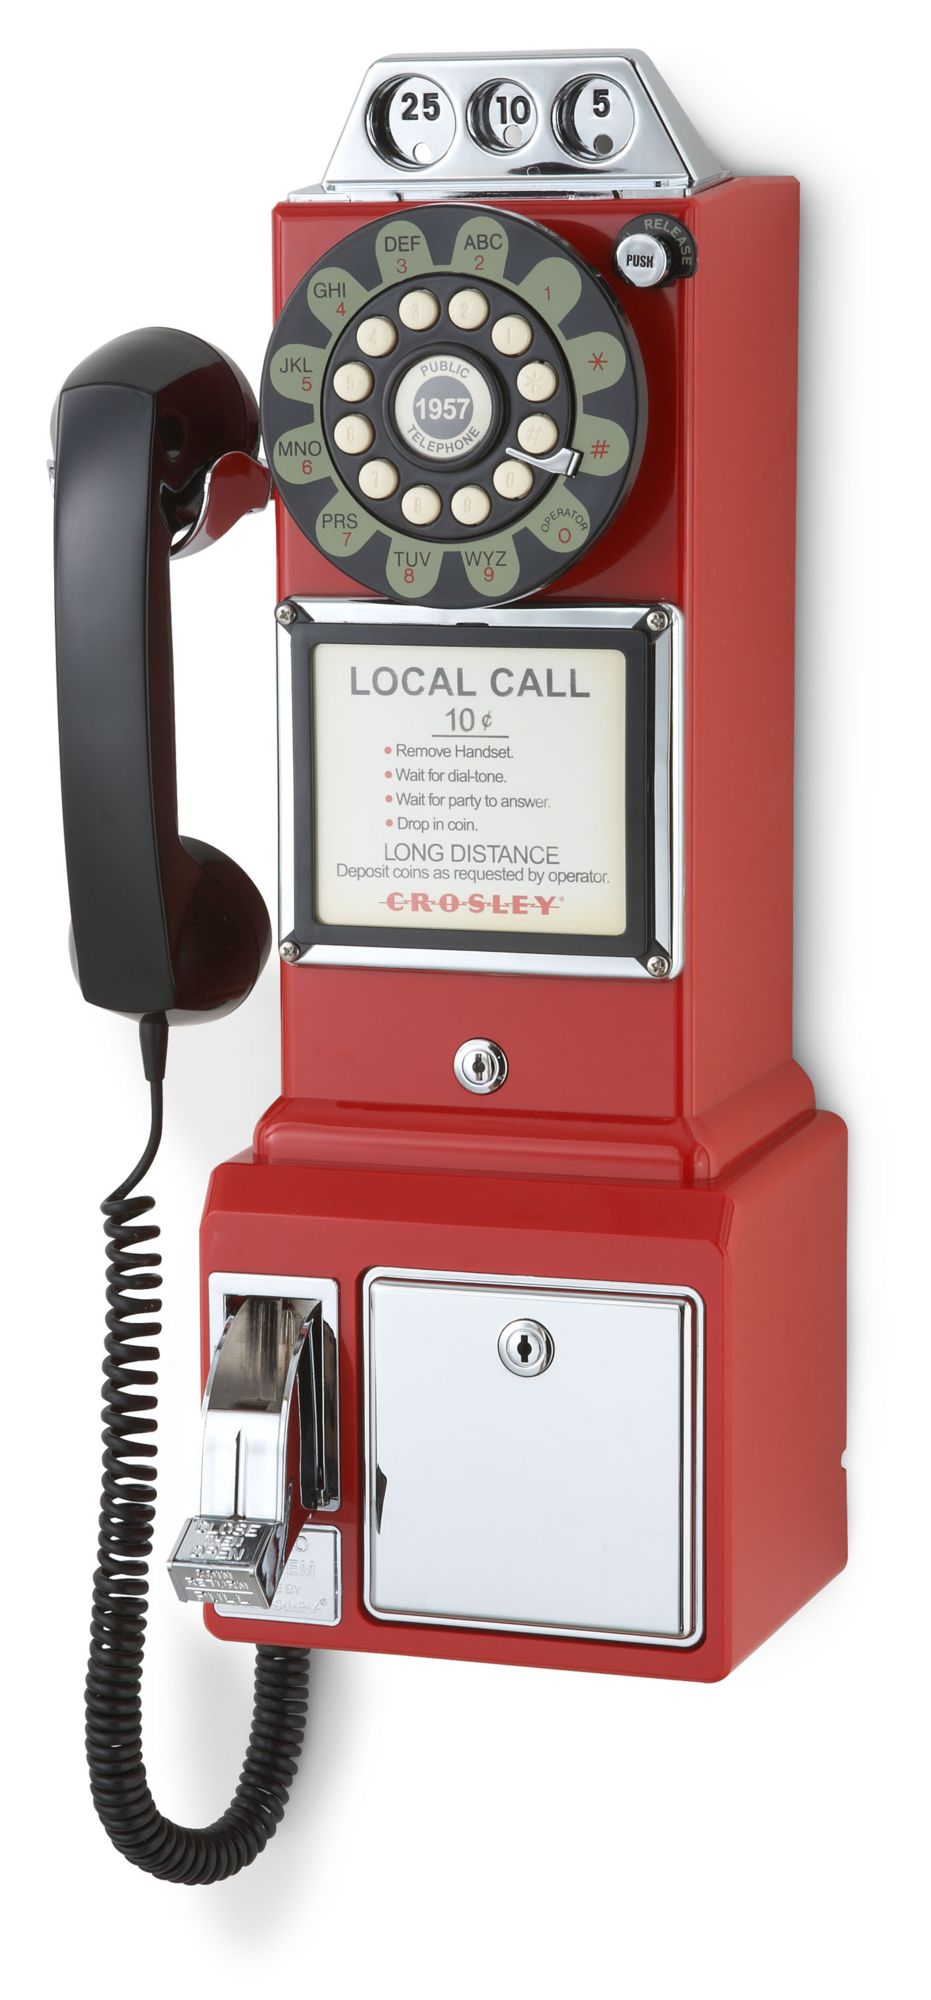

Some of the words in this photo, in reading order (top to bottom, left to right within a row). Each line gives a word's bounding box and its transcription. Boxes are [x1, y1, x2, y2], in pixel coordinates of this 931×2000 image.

[401, 92, 441, 121] 25
[495, 96, 531, 125] 10
[592, 88, 611, 118] 5
[384, 235, 421, 252] DEF
[464, 233, 503, 251] ABC
[644, 218, 692, 266] RELEASE
[396, 258, 407, 274] 3
[473, 255, 485, 271] 2
[626, 254, 654, 268] PUSH
[313, 282, 346, 299] GHI
[544, 285, 551, 301] 1
[335, 302, 347, 317] 4
[279, 357, 313, 374] JKL
[420, 360, 470, 379] PUBLIC
[301, 376, 313, 392] 5
[415, 397, 471, 421] 1957
[407, 423, 480, 454] TELEPHONE
[278, 440, 322, 457] MNO
[302, 459, 313, 475] 6
[322, 513, 358, 530] PRS
[540, 507, 589, 533] OPERATOR
[342, 532, 353, 547] 7
[393, 551, 432, 567] TUV
[464, 550, 507, 567] WYZ
[403, 568, 415, 584] 8
[483, 566, 495, 583] 9
[350, 665, 477, 697] LOCAL
[489, 667, 591, 698] CALL
[445, 707, 476, 733] 10
[481, 710, 493, 731] ¢
[395, 743, 452, 758] Remove
[455, 744, 514, 760] Handset.
[395, 768, 425, 783] Wait
[428, 768, 445, 783] for
[448, 768, 507, 784] dial-tone.
[396, 792, 426, 807] Wait
[428, 792, 445, 807] for
[448, 794, 482, 811] party
[484, 794, 498, 808] to
[500, 796, 552, 809] answer.
[397, 816, 430, 834] Drop
[432, 817, 444, 831] in
[447, 817, 479, 832] coin.
[384, 842, 445, 863] LONG
[451, 844, 561, 865] DISTANCE
[336, 863, 389, 881] Deposit
[392, 864, 430, 880] coins
[432, 868, 450, 880] as
[453, 867, 524, 884] requested
[528, 868, 545, 886] by
[548, 869, 610, 886] operator.
[196, 1521, 261, 1537] CLOSE
[190, 1544, 246, 1561] OPEN
